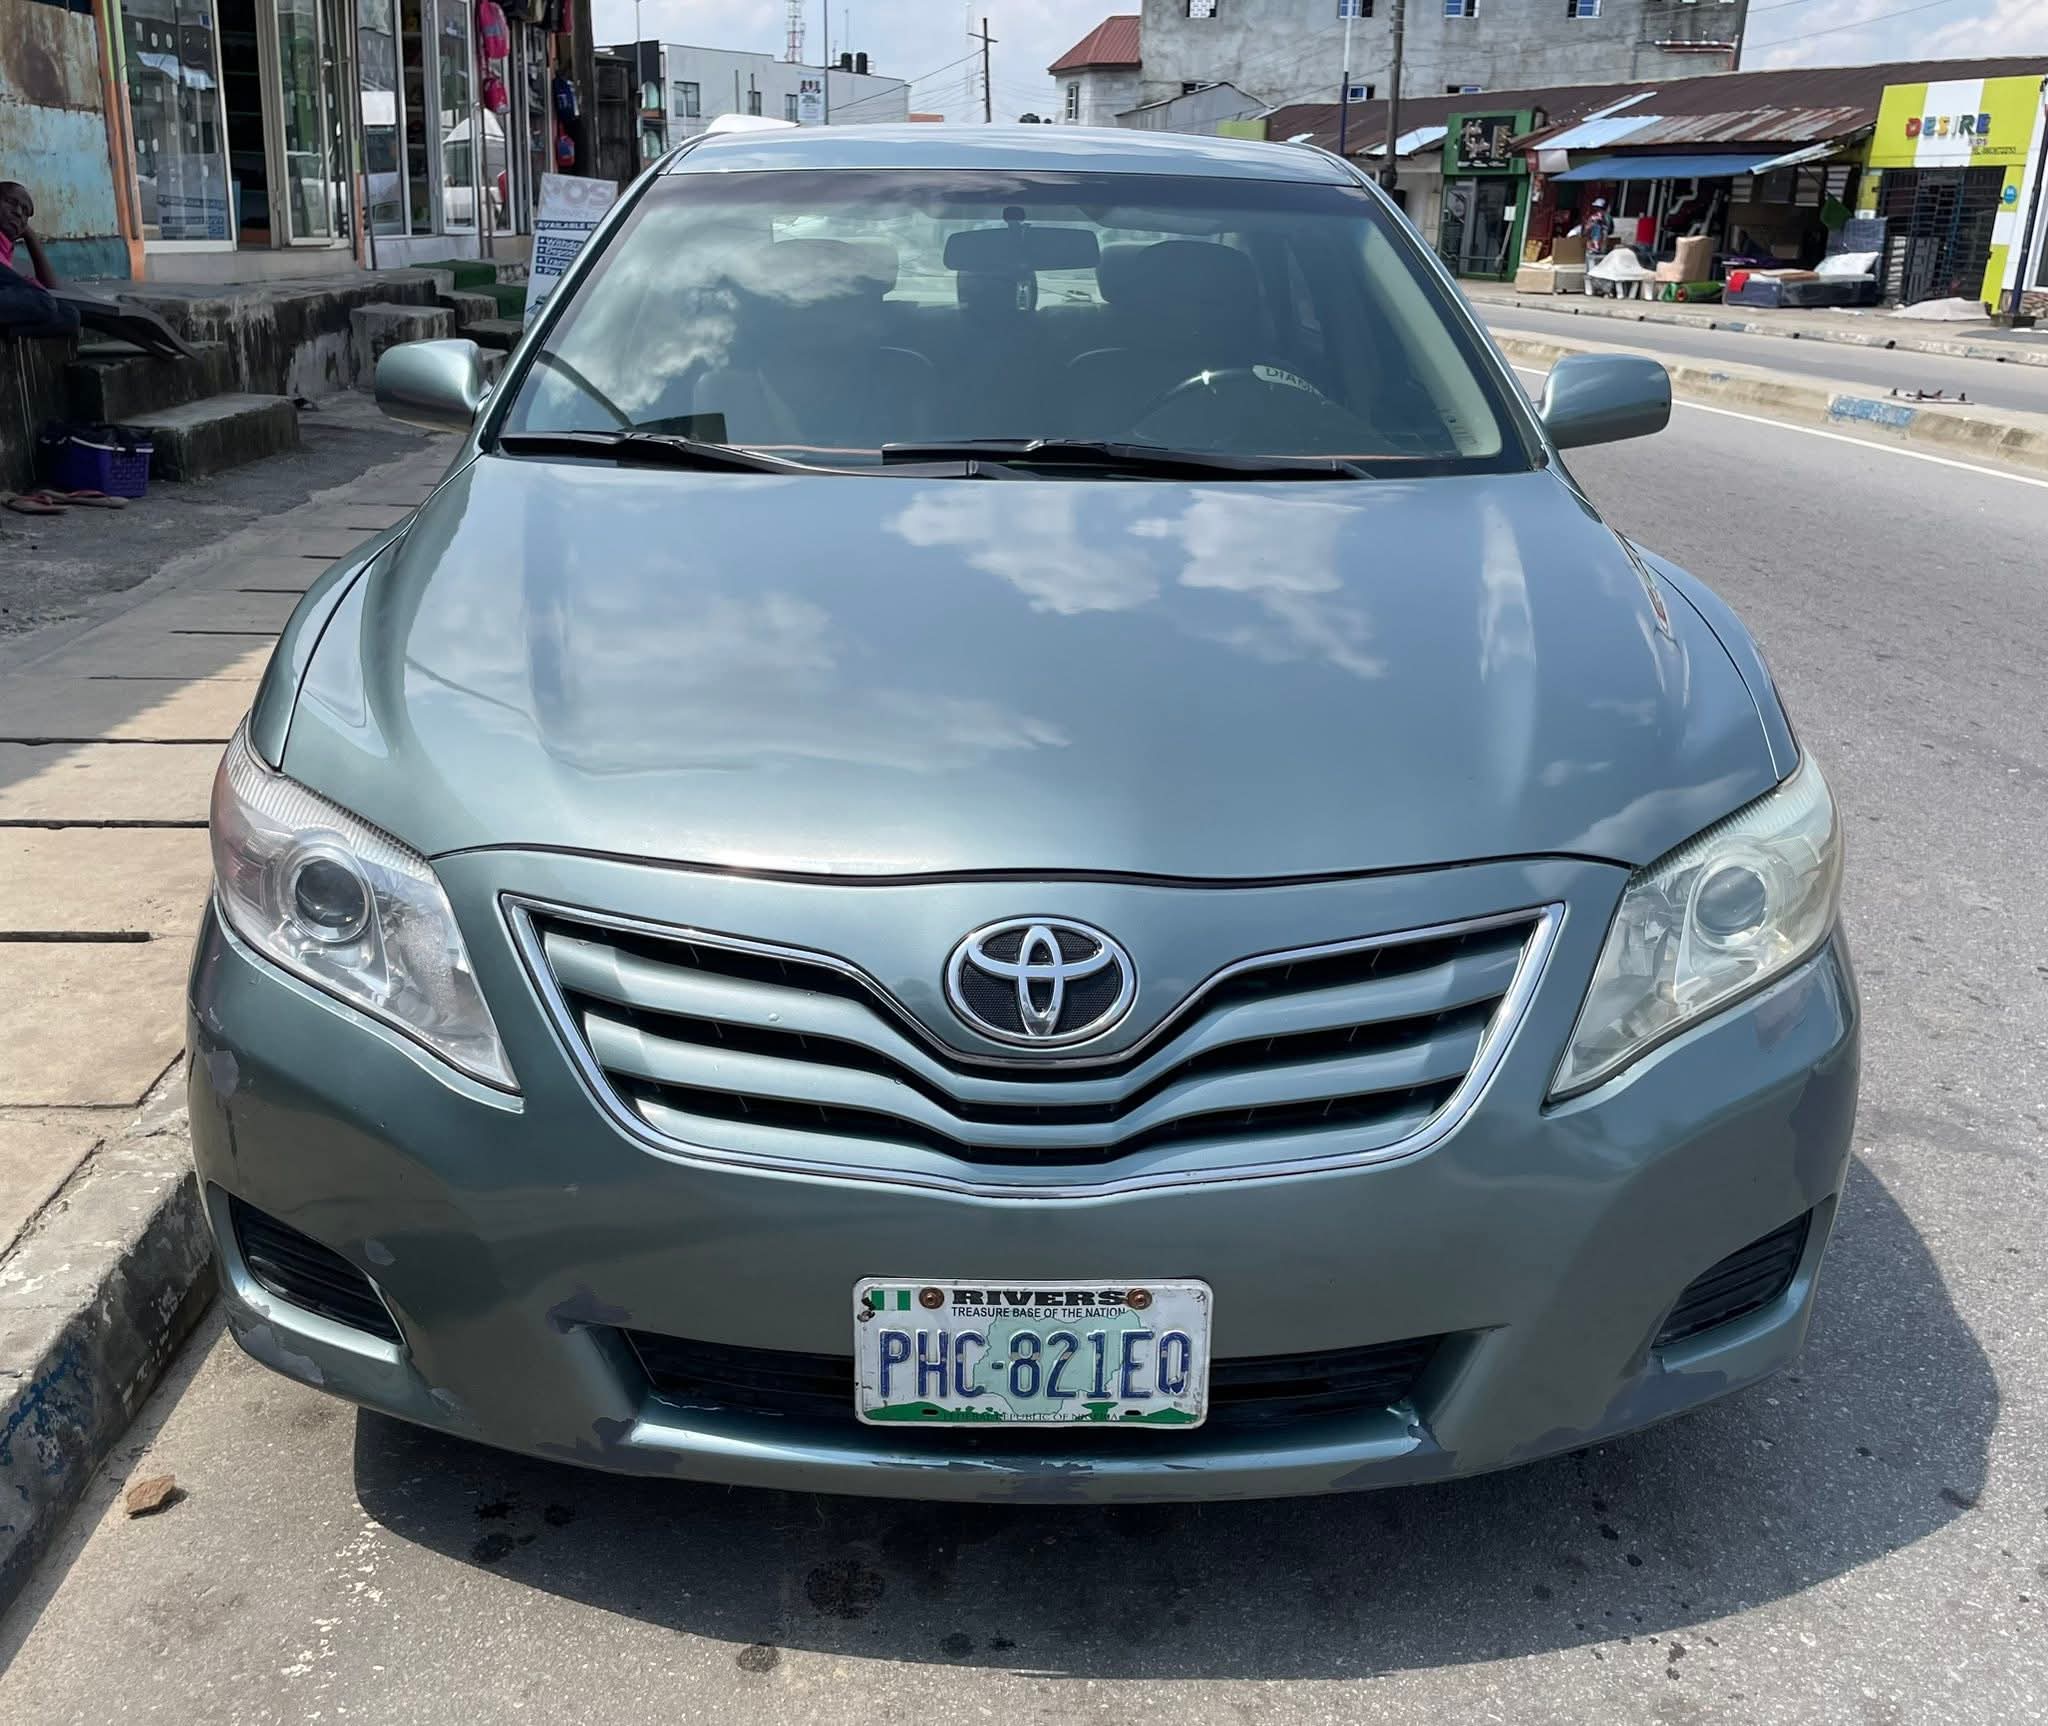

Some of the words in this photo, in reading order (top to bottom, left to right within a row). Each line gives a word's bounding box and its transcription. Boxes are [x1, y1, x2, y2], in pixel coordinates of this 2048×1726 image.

[1905, 113, 1991, 138] DESIRE
[952, 1290, 1127, 1306] RIVERS
[952, 1307, 1009, 1318] TREASURE
[1013, 1308, 1041, 1318] BASE
[1044, 1308, 1058, 1318] OF
[1062, 1308, 1082, 1318] THE
[1086, 1308, 1126, 1318] NATION
